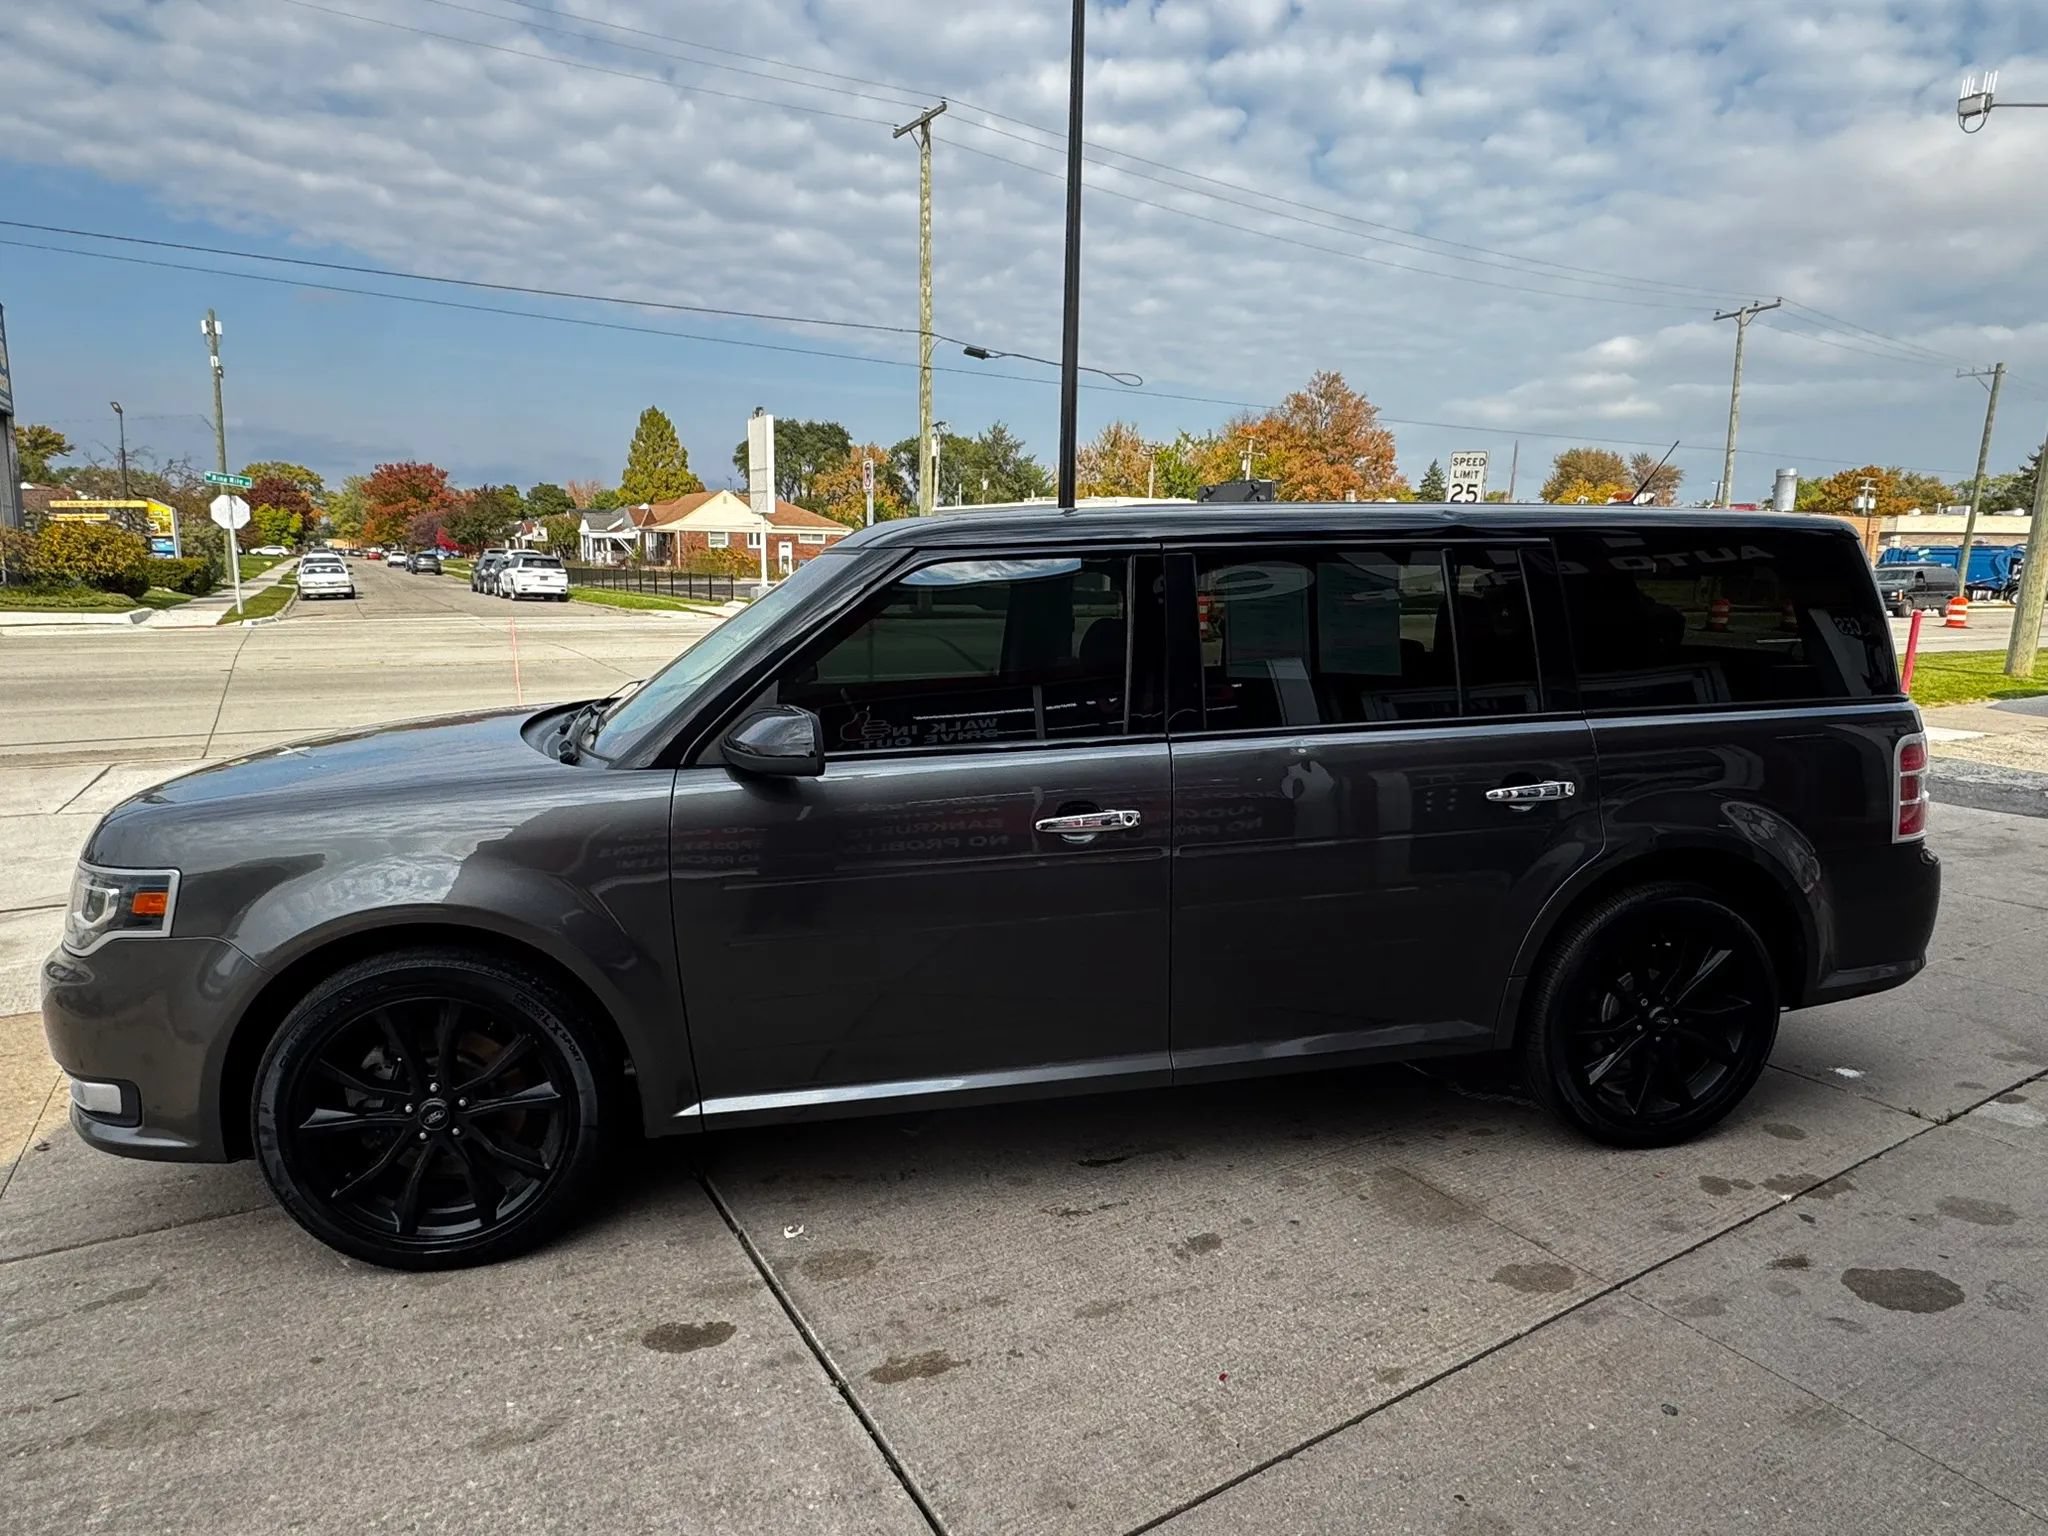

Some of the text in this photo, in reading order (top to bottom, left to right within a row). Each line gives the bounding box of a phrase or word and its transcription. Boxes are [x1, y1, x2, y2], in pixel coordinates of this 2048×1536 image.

[1453, 457, 1486, 467] SPEED
[1453, 470, 1480, 480] LIMIT
[1450, 483, 1478, 502] 25
